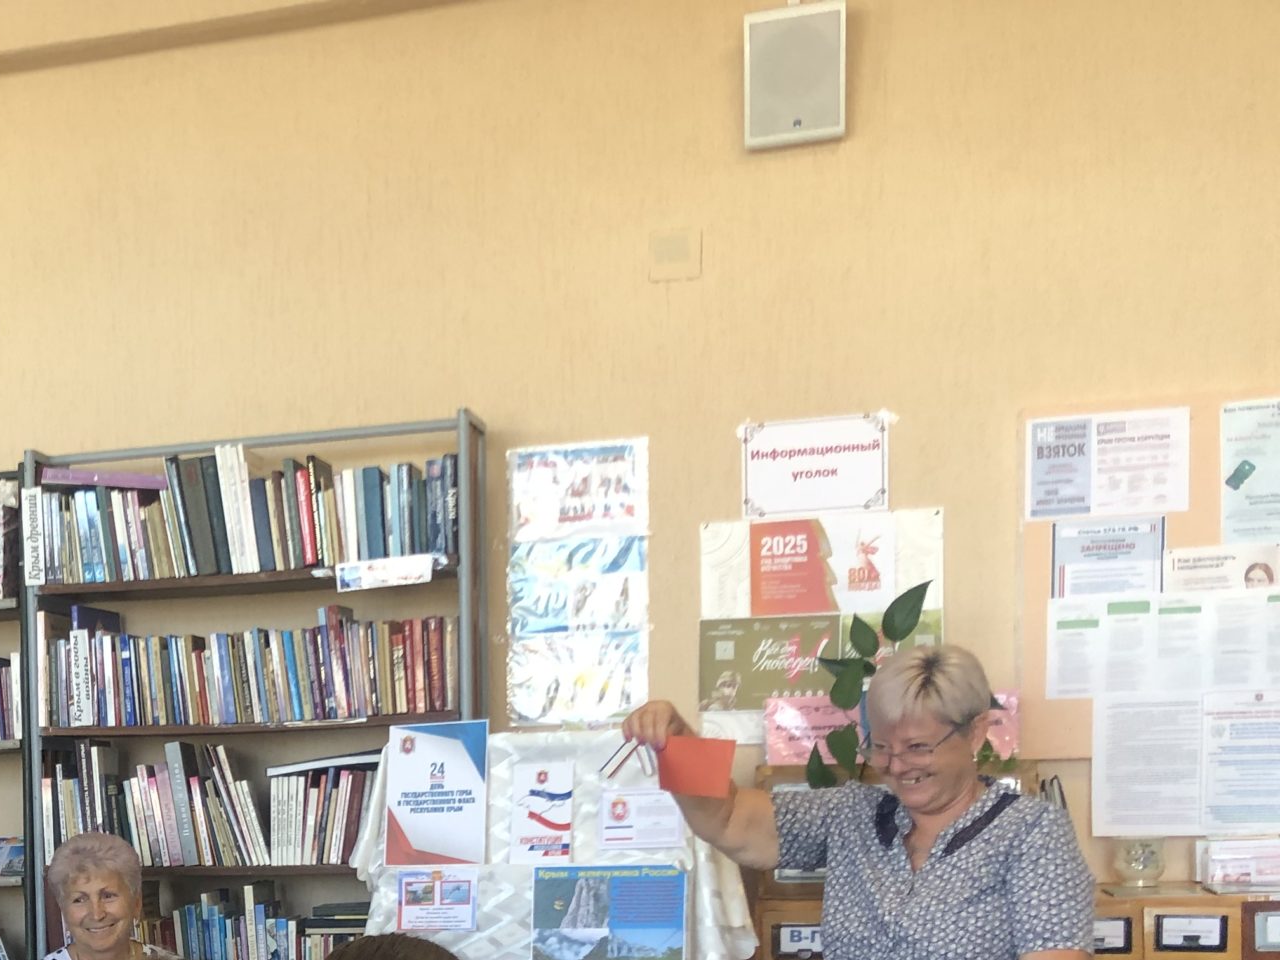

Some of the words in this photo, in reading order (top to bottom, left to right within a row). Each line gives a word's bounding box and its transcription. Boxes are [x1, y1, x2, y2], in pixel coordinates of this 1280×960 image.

[750, 438, 881, 461] Информационный
[1036, 442, 1086, 460] ВЗЯТОК
[791, 466, 838, 482] уголок
[28, 494, 41, 543] древний
[760, 534, 808, 557] 2025
[27, 544, 41, 581] Крым
[73, 682, 84, 723] Крым
[430, 762, 445, 776] 24
[538, 869, 569, 879] Крым
